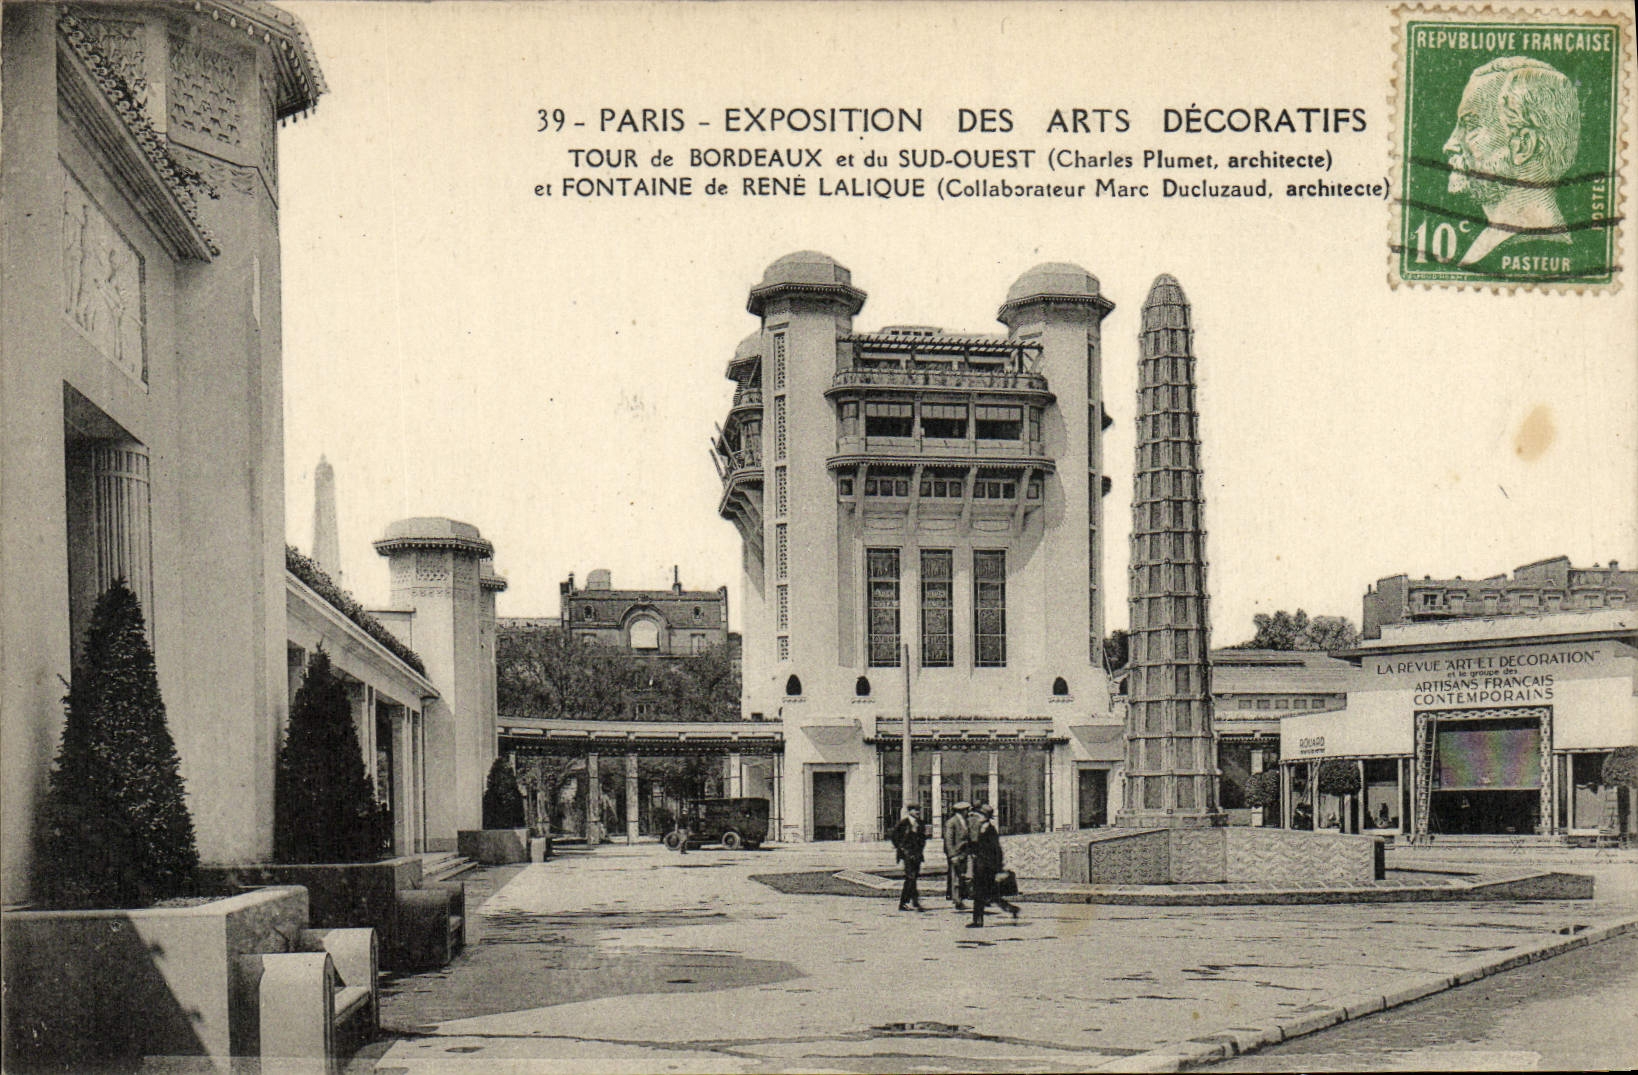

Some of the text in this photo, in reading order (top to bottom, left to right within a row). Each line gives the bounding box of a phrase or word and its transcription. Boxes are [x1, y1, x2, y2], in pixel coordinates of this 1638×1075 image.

[1522, 32, 1611, 53] FRANÇAISE
[1502, 256, 1571, 272] PASTEUR
[1377, 664, 1394, 675] LA
[1397, 660, 1441, 674] REVUE
[1477, 655, 1494, 669] ET
[1503, 667, 1518, 675] des
[1414, 679, 1479, 693] ARTISANS
[1413, 687, 1554, 706] CONTEMPORAINS
